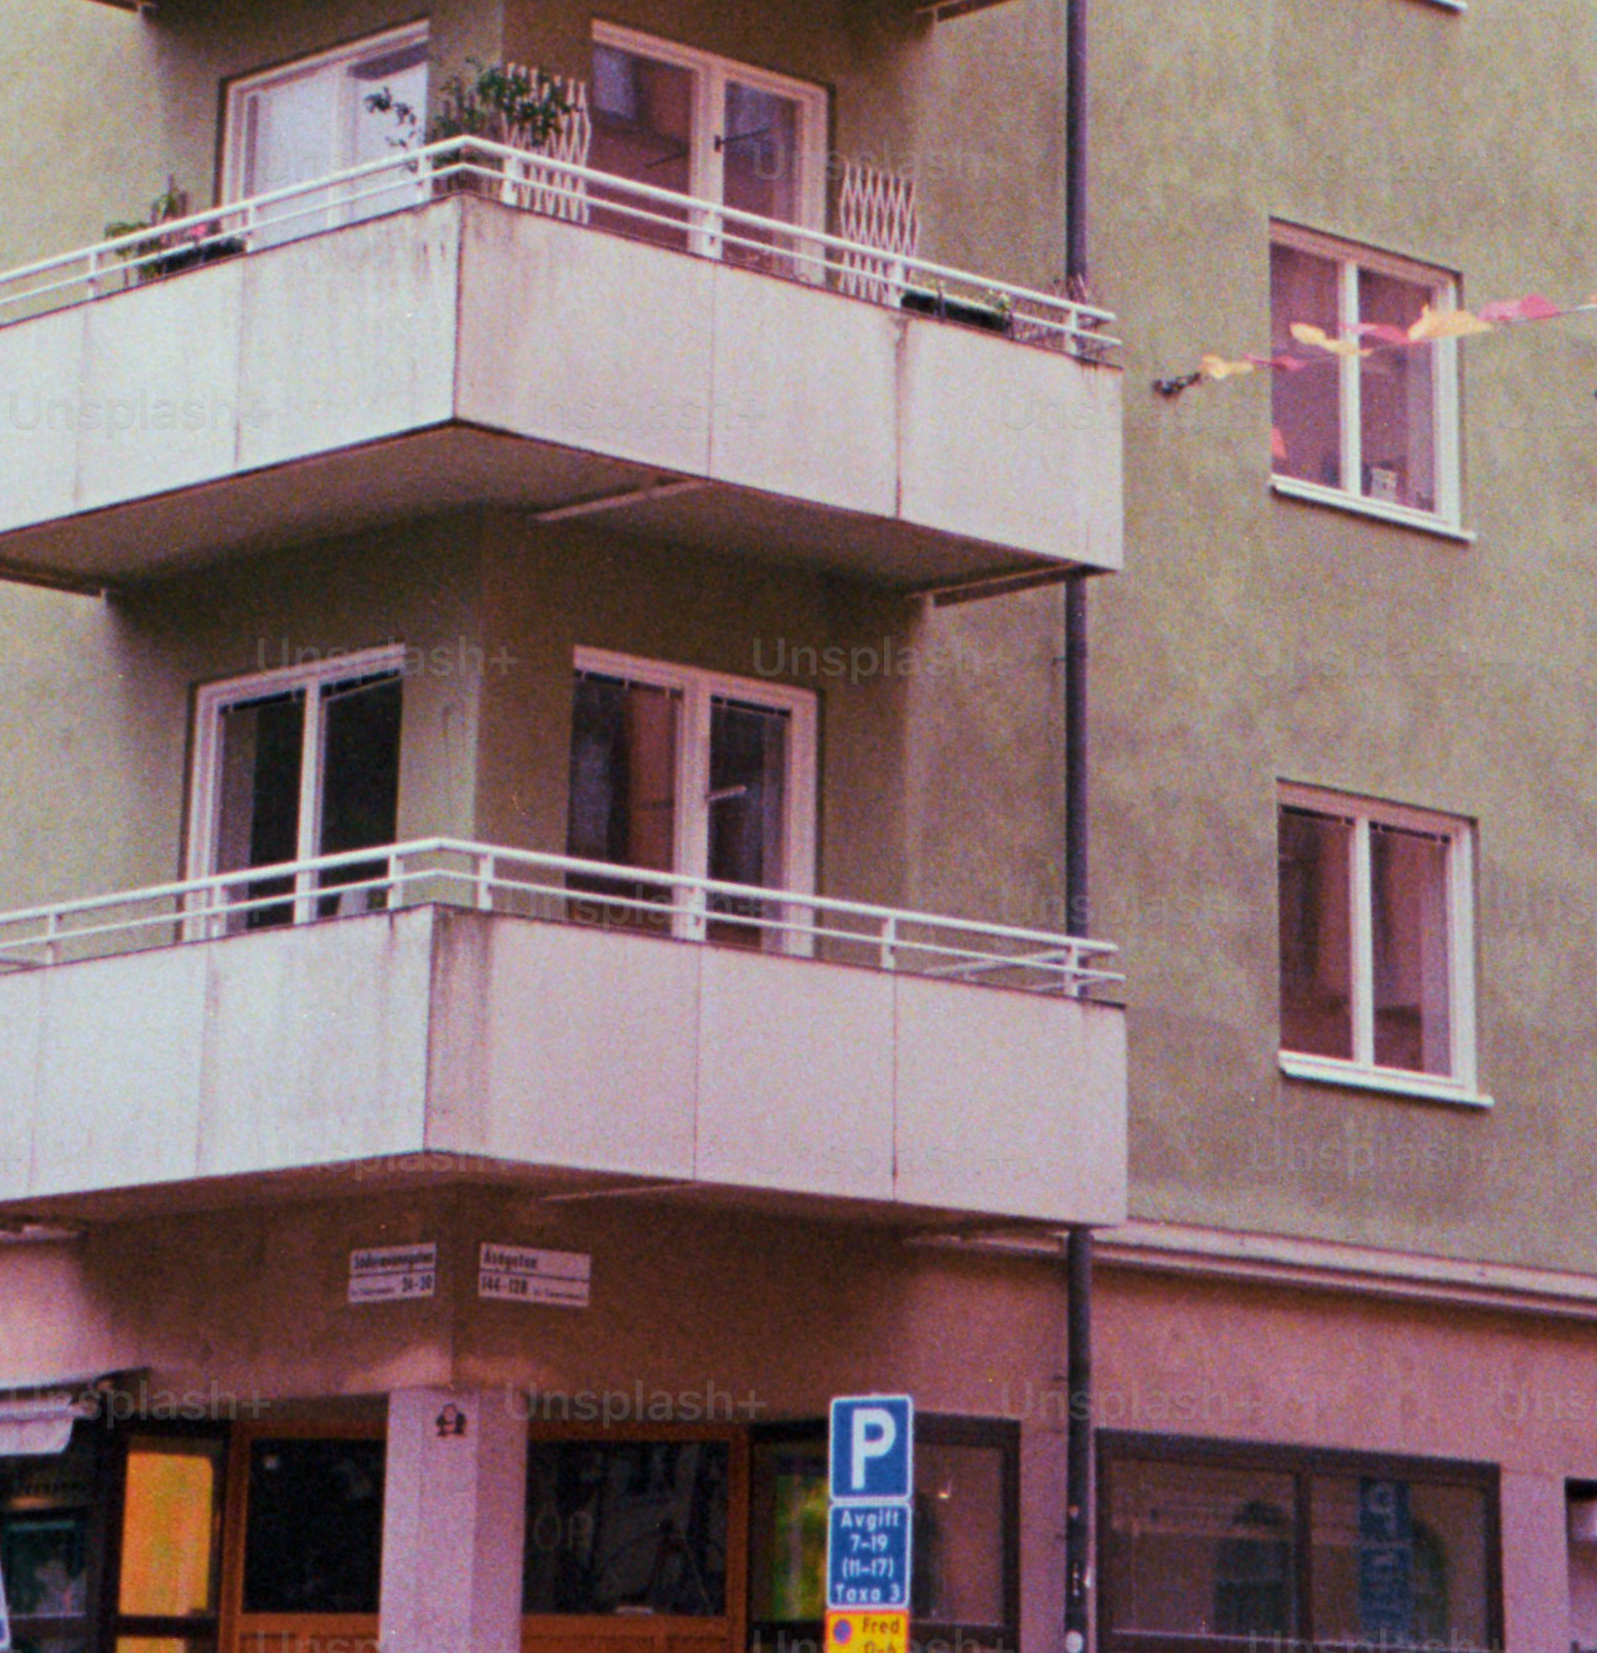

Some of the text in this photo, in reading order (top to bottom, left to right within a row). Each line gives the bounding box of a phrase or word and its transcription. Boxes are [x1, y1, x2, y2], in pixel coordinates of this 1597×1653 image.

[851, 1408, 897, 1490] P
[840, 1510, 900, 1530] Avgift
[835, 1584, 901, 1602] Taxa 3
[862, 1616, 900, 1634] Fred
